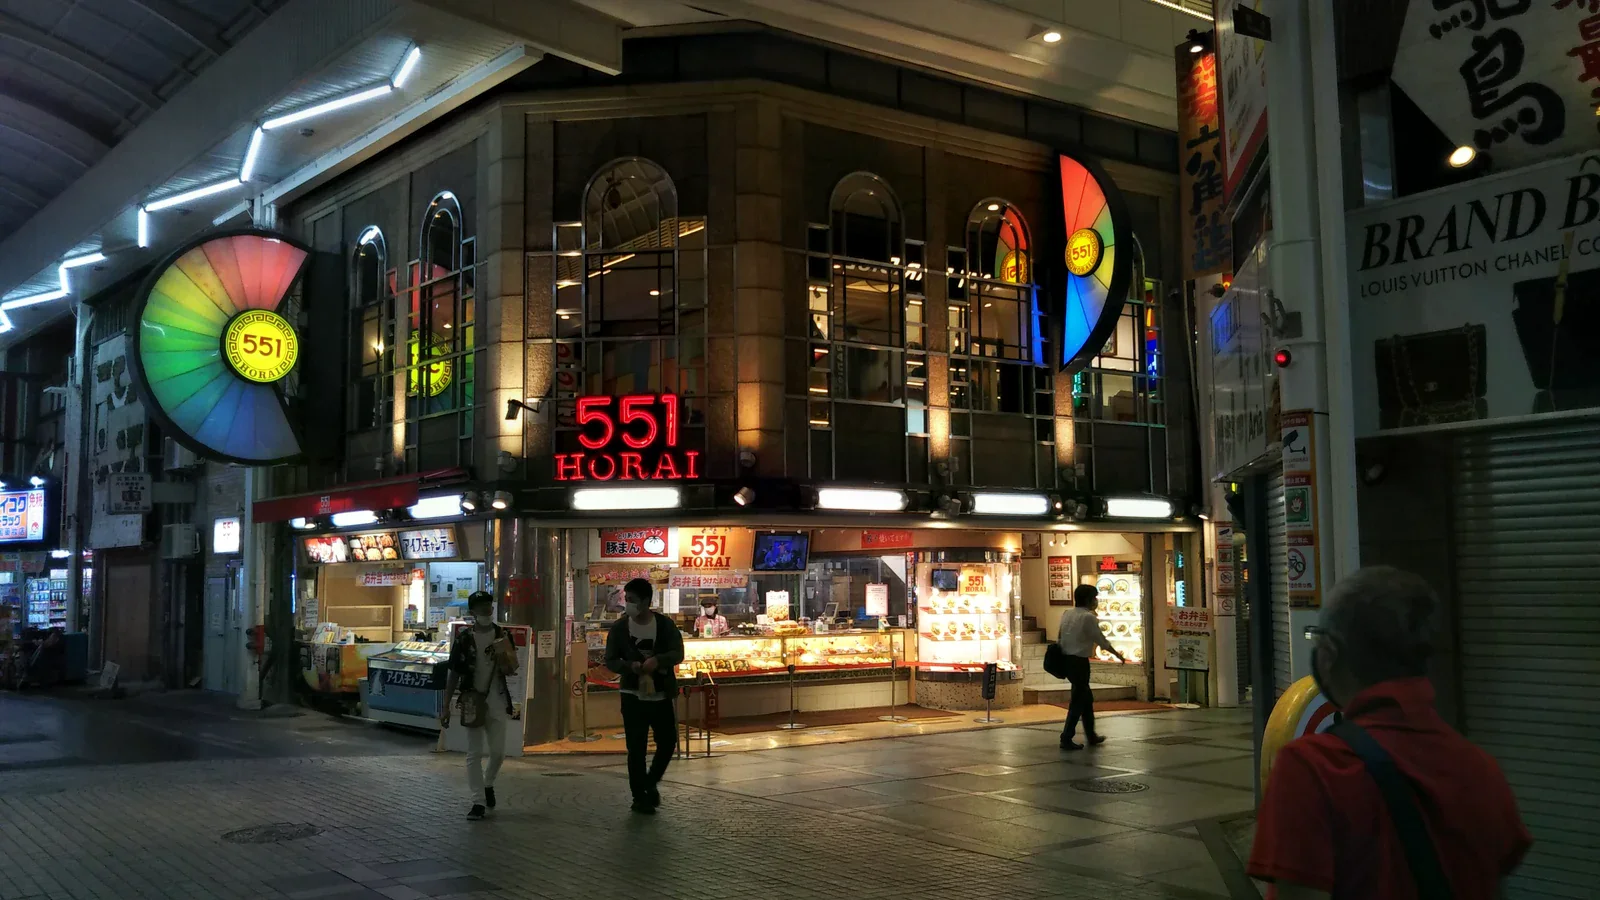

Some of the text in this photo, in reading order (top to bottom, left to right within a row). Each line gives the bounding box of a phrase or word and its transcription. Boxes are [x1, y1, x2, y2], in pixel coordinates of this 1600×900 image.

[1357, 187, 1547, 272] BRAND
[1072, 244, 1091, 261] 551
[1360, 276, 1408, 299] LOUIS
[1410, 259, 1488, 287] VUITTON
[1494, 244, 1569, 272] CHANEL
[243, 333, 282, 359] 551
[238, 361, 283, 380] HORAI
[575, 393, 679, 449] 551
[553, 451, 700, 481] HORAI
[605, 541, 641, 555] 豚まん
[691, 535, 727, 556] 551
[681, 556, 732, 568] HORAI
[671, 575, 701, 587] お弁当
[967, 575, 984, 587] 551
[1178, 610, 1209, 622] お弁当
